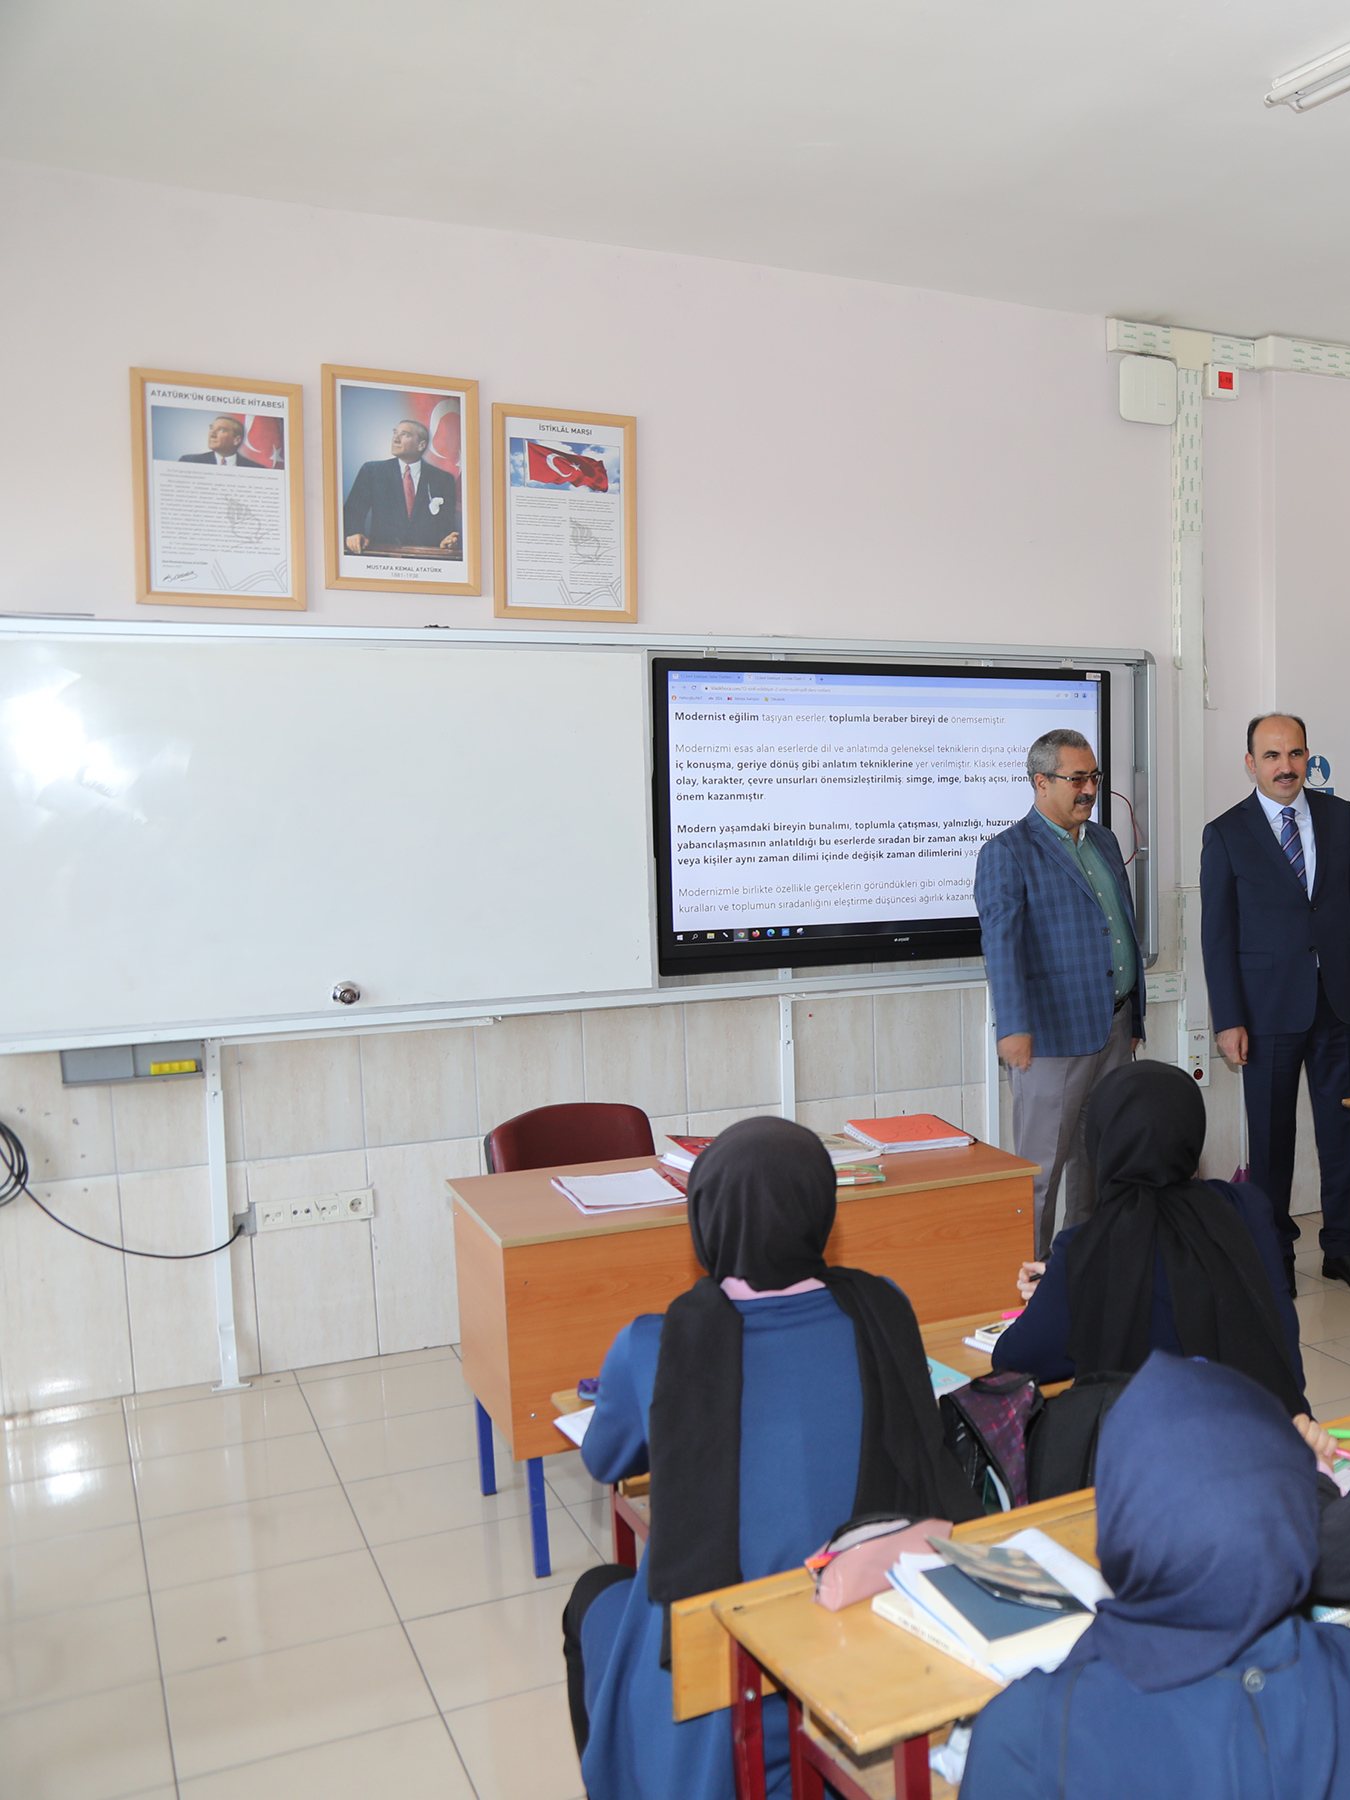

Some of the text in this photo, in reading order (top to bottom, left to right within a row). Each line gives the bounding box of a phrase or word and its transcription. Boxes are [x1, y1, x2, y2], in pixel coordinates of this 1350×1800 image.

[150, 389, 285, 409] ATATÜRK'ÜN GENÇLİĞE HİTABESİ
[538, 423, 592, 436] İSTİKLÂL MARŞI
[366, 564, 394, 572] MUSTAFA
[416, 566, 442, 574] ATATÜRK
[675, 712, 1006, 726] Modernist eğilim taşıyan eserler, toplumla beraber bireyi de önemsemiştir.
[675, 744, 732, 752] Modernizmi
[756, 744, 776, 752] alan
[778, 744, 818, 752] eserlerde
[820, 744, 832, 752] dil
[846, 744, 888, 753] anlatımda
[892, 744, 935, 755] geleneksel
[937, 744, 979, 754] tekniklerin
[981, 745, 1004, 755] dışına
[1007, 745, 1029, 754] çıkılar
[676, 760, 684, 770] iç
[687, 760, 734, 770] konuşma,
[737, 760, 767, 770] geriye
[770, 760, 798, 770] dönüş
[802, 760, 820, 770] gibi
[822, 760, 857, 768] anlatım
[860, 760, 913, 768] tekniklerine
[916, 761, 928, 769] yer
[930, 760, 971, 769] verilmiştir.
[974, 760, 996, 768] Klasik
[676, 776, 698, 787] olay,
[702, 776, 744, 786] karakter,
[748, 777, 773, 786] çevre
[776, 776, 818, 784] unsurları
[906, 775, 934, 785] simge,
[938, 775, 961, 785] imge,
[964, 774, 986, 784] bakış
[988, 776, 1009, 784] açısı,
[676, 792, 766, 802] önem kazanmıştır.
[677, 818, 1020, 834] Modern yaşamdaki bireyin bunalımı, toplumla çatışması, yalnızlığı, huzursu
[677, 840, 766, 852] yabancılaşmasının
[769, 838, 816, 848] anlatıldığı
[820, 837, 831, 846] bu
[834, 836, 876, 846] eserlerde
[878, 836, 910, 844] sıradan
[914, 834, 925, 844] bir
[958, 834, 978, 842] akışı
[980, 833, 995, 842] kull
[678, 857, 700, 868] veya
[704, 856, 732, 866] kişiler
[735, 856, 756, 866] aynı
[792, 852, 819, 862] dilimi
[822, 852, 850, 863] içinde
[852, 850, 884, 861] değişik
[918, 848, 962, 858] dilimlerini
[679, 878, 973, 897] Modernizmle birlikte özellikle gerçeklerin göründükleri gibi olmadığı
[679, 903, 716, 913] kuralları
[719, 904, 729, 912] ve
[732, 901, 776, 912] toplumun
[779, 899, 832, 910] sıradanlığını
[834, 896, 872, 906] eleştirme
[876, 894, 916, 905] düşüncesi
[919, 893, 943, 904] ağırlık
